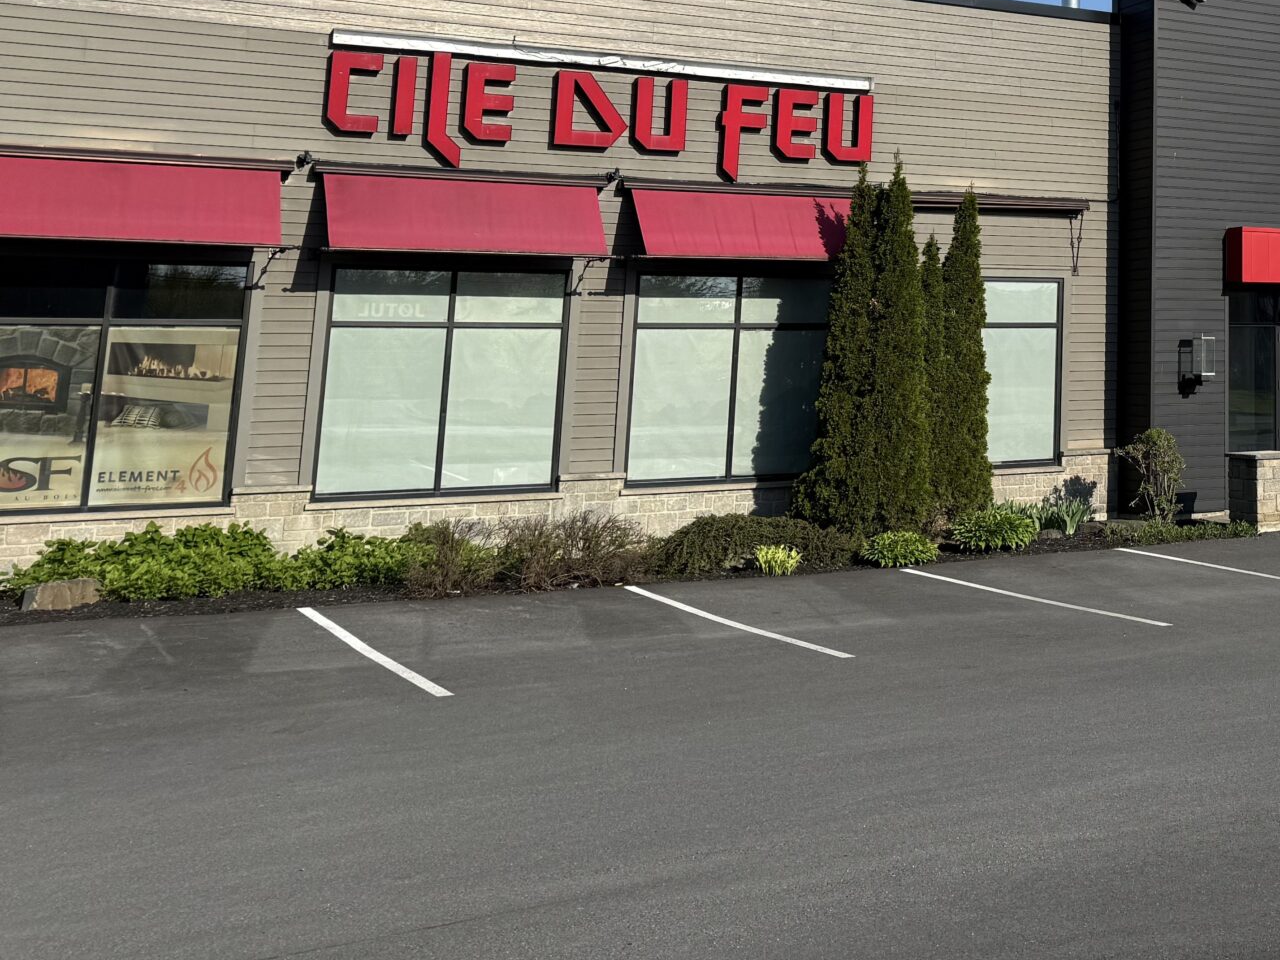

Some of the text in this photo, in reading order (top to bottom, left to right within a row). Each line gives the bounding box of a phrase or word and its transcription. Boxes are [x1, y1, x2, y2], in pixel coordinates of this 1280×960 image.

[553, 69, 688, 152] DU
[722, 83, 874, 183] FEU
[97, 469, 181, 484] ELEMENT
